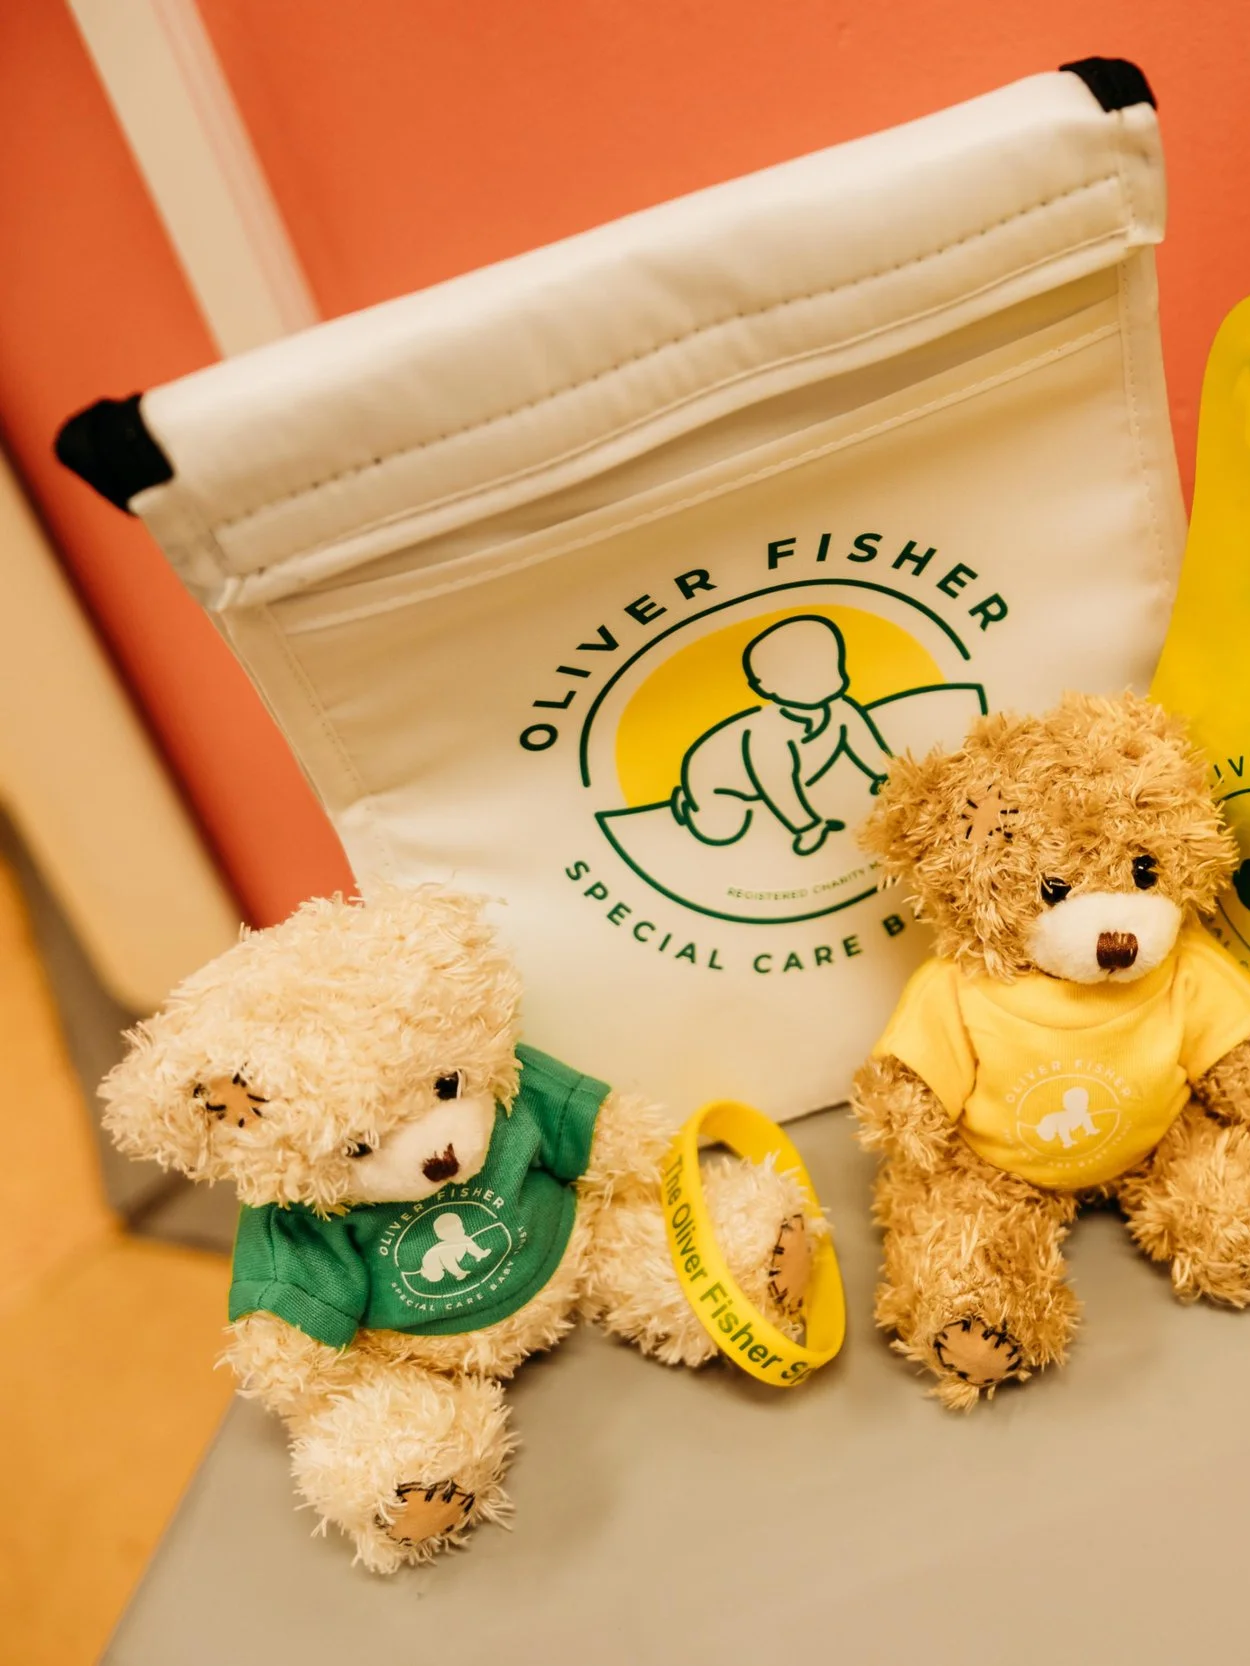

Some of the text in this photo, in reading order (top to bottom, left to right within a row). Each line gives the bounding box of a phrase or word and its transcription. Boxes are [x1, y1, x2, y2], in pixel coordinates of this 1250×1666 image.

[518, 532, 1009, 752] OLIVER FISHER
[564, 859, 864, 974] SPECIAL CARE
[727, 869, 866, 901] REGISTERED CHARITY
[1005, 1058, 1132, 1103] OLIVER FISHER
[664, 1153, 684, 1207] The
[379, 1187, 505, 1257] OLIVER FISHER
[671, 1202, 708, 1283] Oliver
[391, 1282, 435, 1312] SPECIAL
[445, 1293, 484, 1311] CARE
[699, 1281, 784, 1370] Fisher
